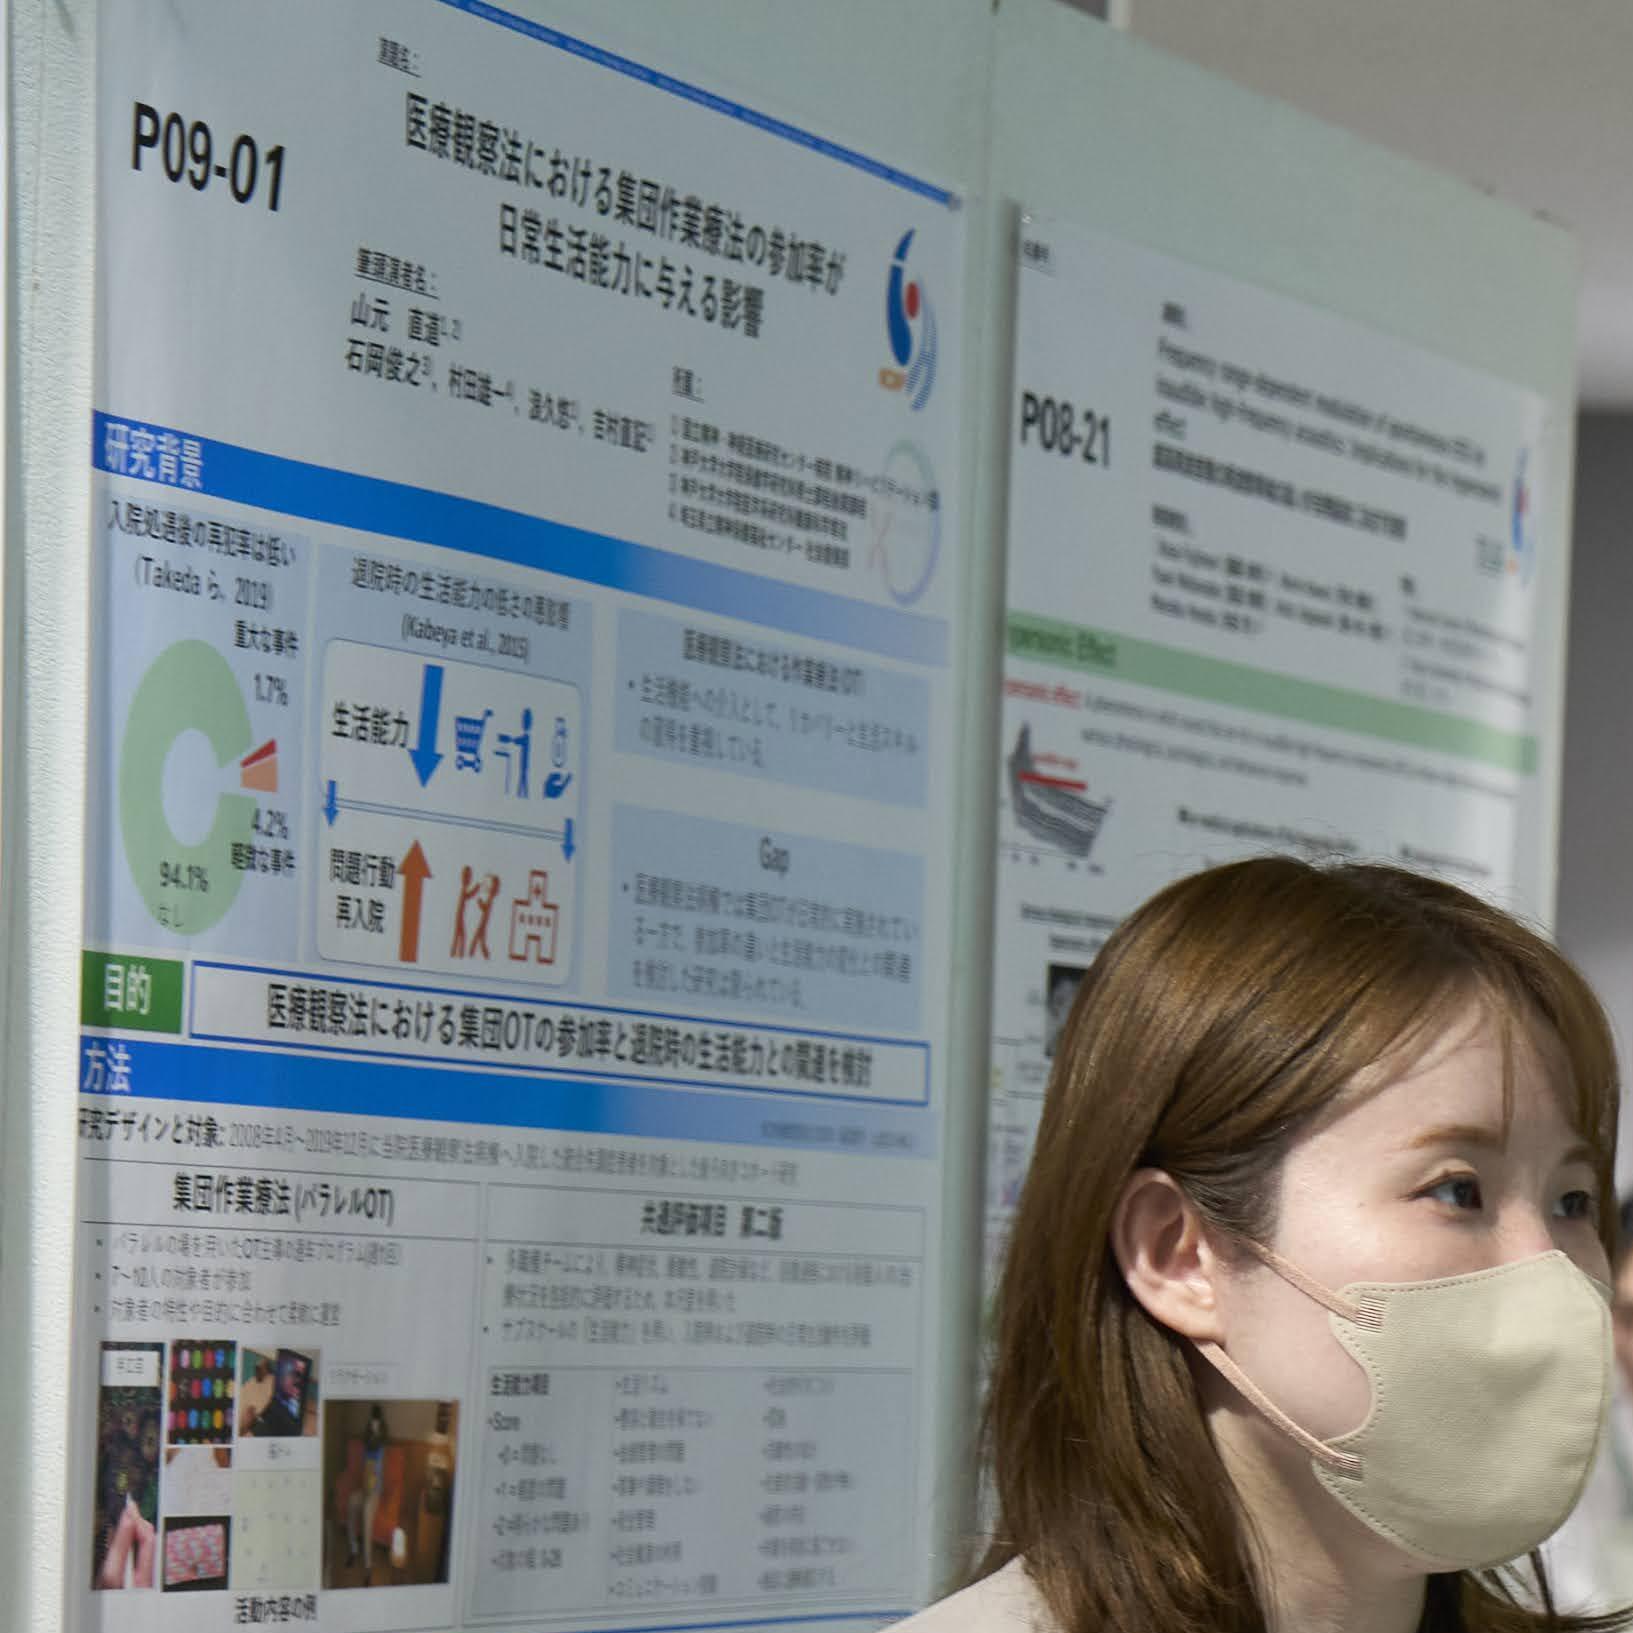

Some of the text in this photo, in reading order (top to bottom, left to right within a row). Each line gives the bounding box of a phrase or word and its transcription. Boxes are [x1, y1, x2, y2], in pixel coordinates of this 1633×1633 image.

[132, 101, 286, 211] P09-01
[499, 203, 765, 338] 日常生活能力に与える影響
[1021, 390, 1111, 468] P08-21
[103, 421, 204, 489] 研究背景
[253, 672, 289, 708] 1.7%
[329, 700, 410, 750] 生活能力
[250, 807, 290, 841] 4.2%
[158, 861, 210, 896] 94.1%
[327, 847, 397, 891] 問題行動
[335, 895, 386, 936] 再入院
[102, 962, 152, 1015] 目的
[83, 1041, 132, 1093] 方法
[234, 1593, 319, 1625] 活動内容の例
